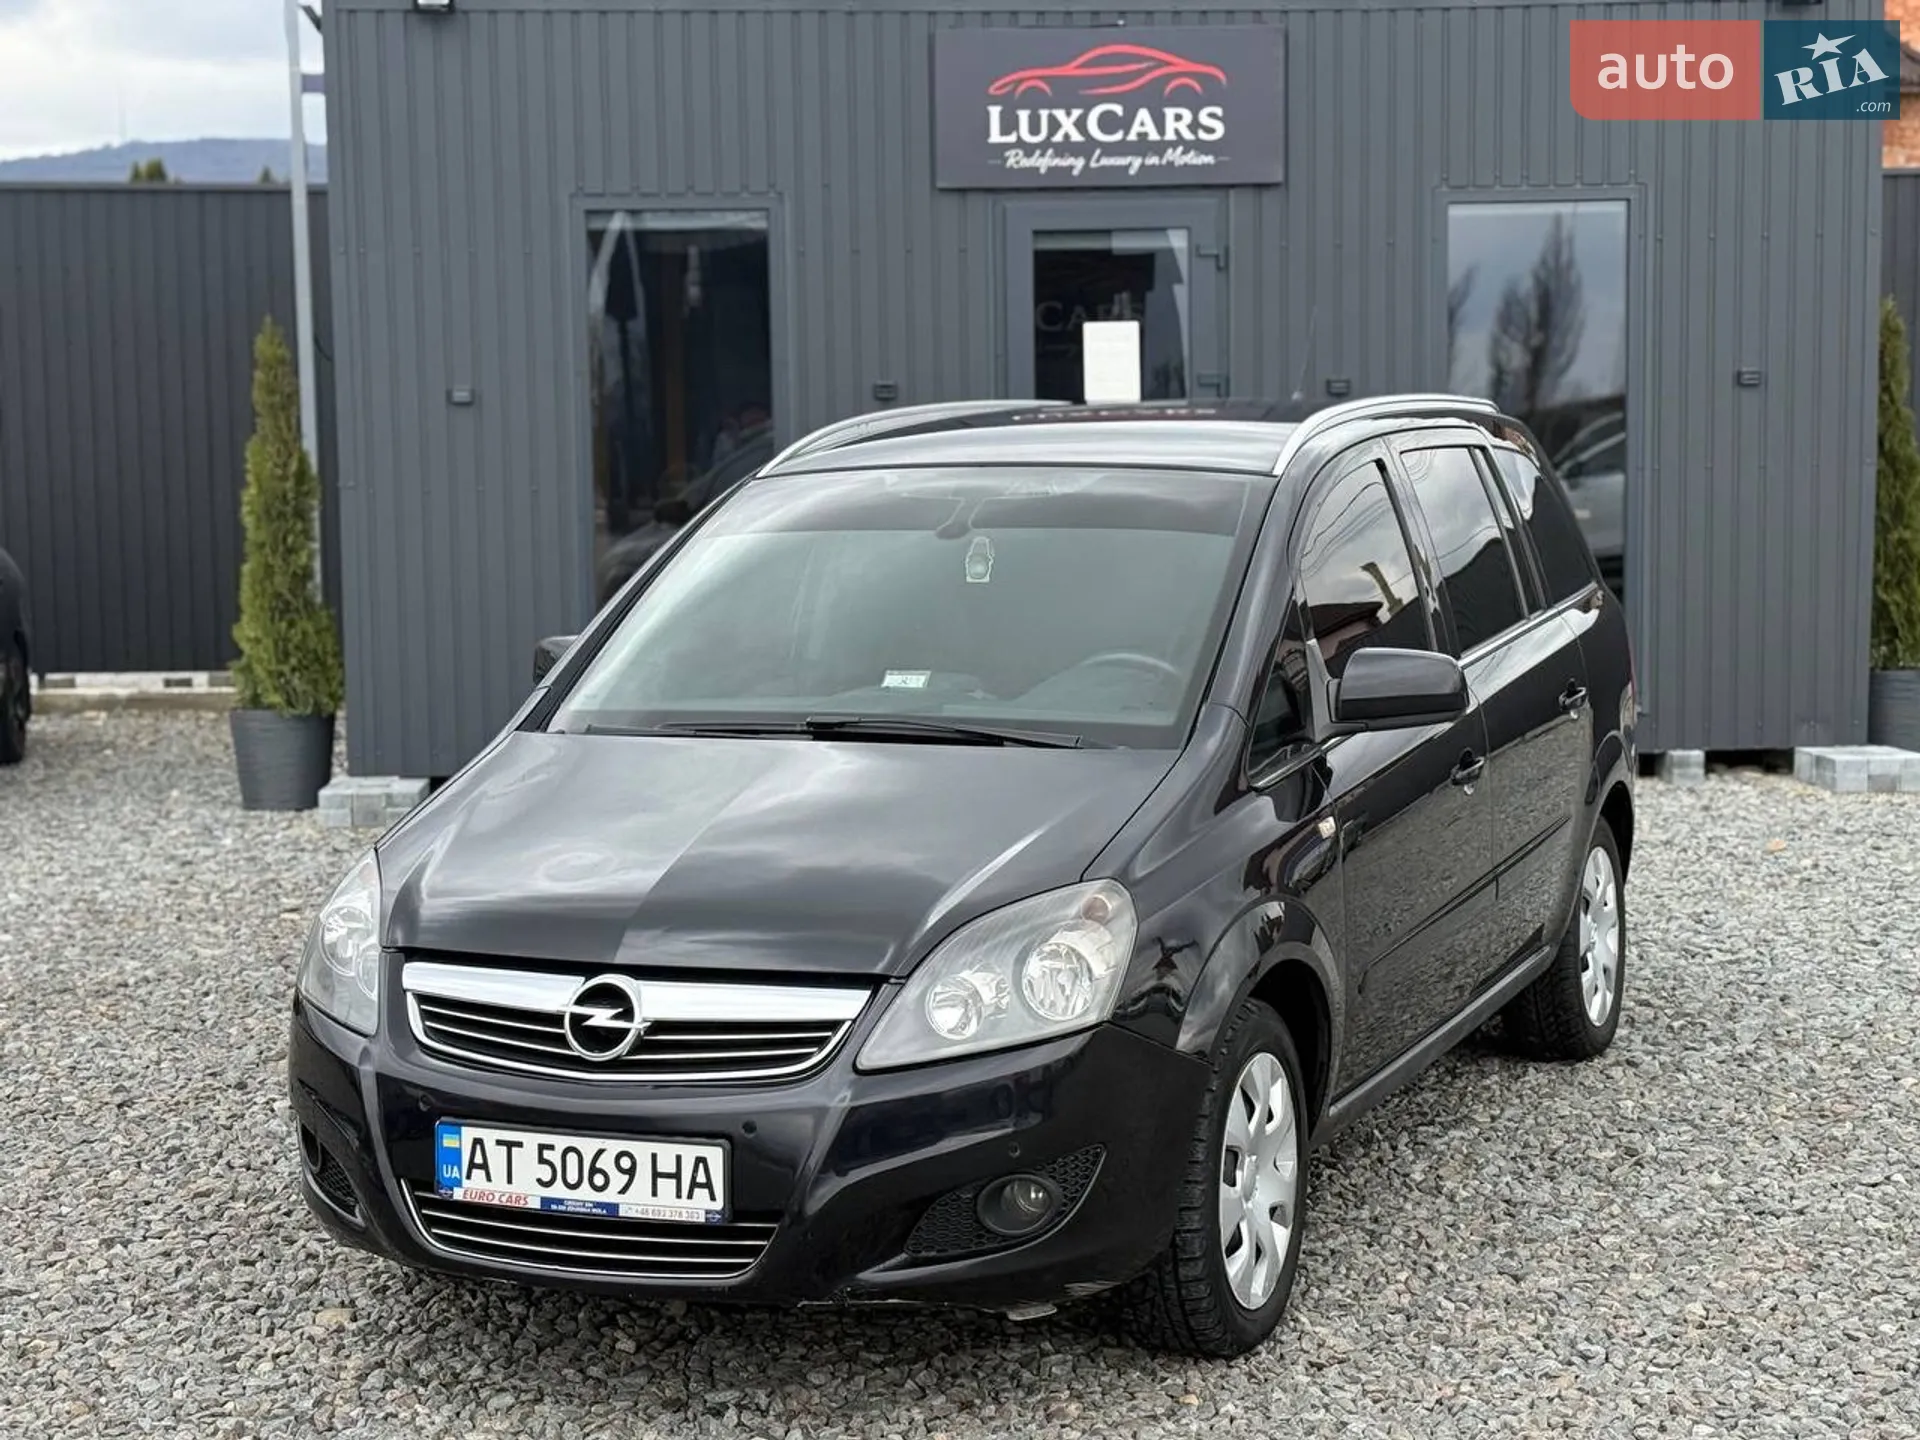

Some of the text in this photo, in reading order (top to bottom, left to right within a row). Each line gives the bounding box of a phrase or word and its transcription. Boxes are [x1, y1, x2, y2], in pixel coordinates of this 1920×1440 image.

[1003, 145, 1216, 177] Redefining Luxury in Motion
[442, 1164, 461, 1180] UA
[465, 1136, 717, 1202] AT 5069 HA
[462, 1189, 529, 1206] EURO CARS
